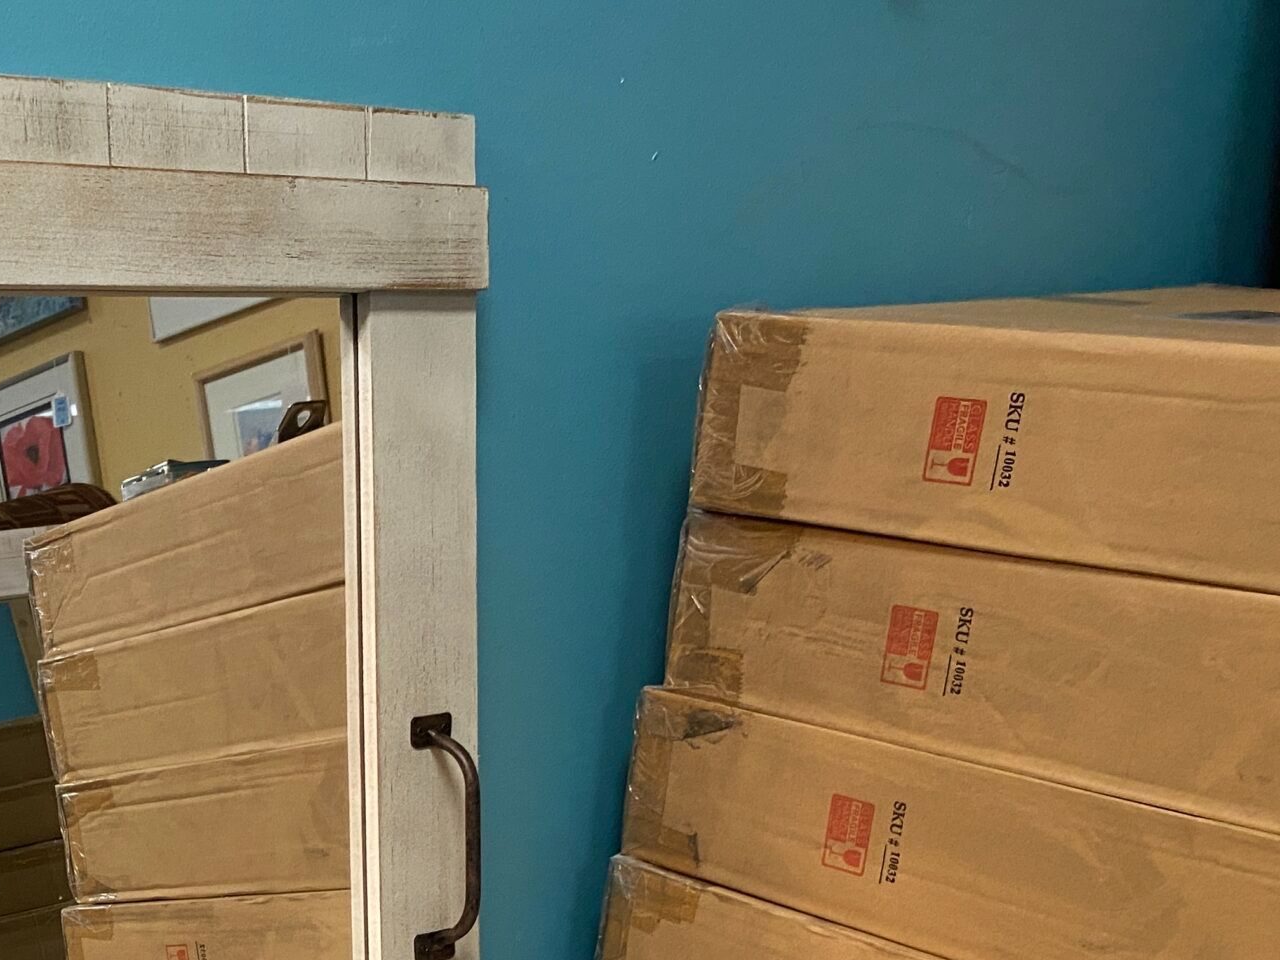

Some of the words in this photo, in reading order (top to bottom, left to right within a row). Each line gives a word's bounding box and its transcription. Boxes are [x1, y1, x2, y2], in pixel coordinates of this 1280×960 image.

[953, 404, 969, 450] FRAGILE
[964, 404, 982, 449] GLASS
[1005, 392, 1025, 432] SKU
[1002, 436, 1016, 445] #
[998, 450, 1016, 487] 10032
[908, 613, 923, 656] FRAGILE
[955, 607, 974, 644] SKU
[953, 646, 966, 655] #
[950, 661, 966, 695] 10032
[889, 801, 907, 836] SKU
[887, 838, 899, 847] #
[885, 852, 900, 883] 10032
